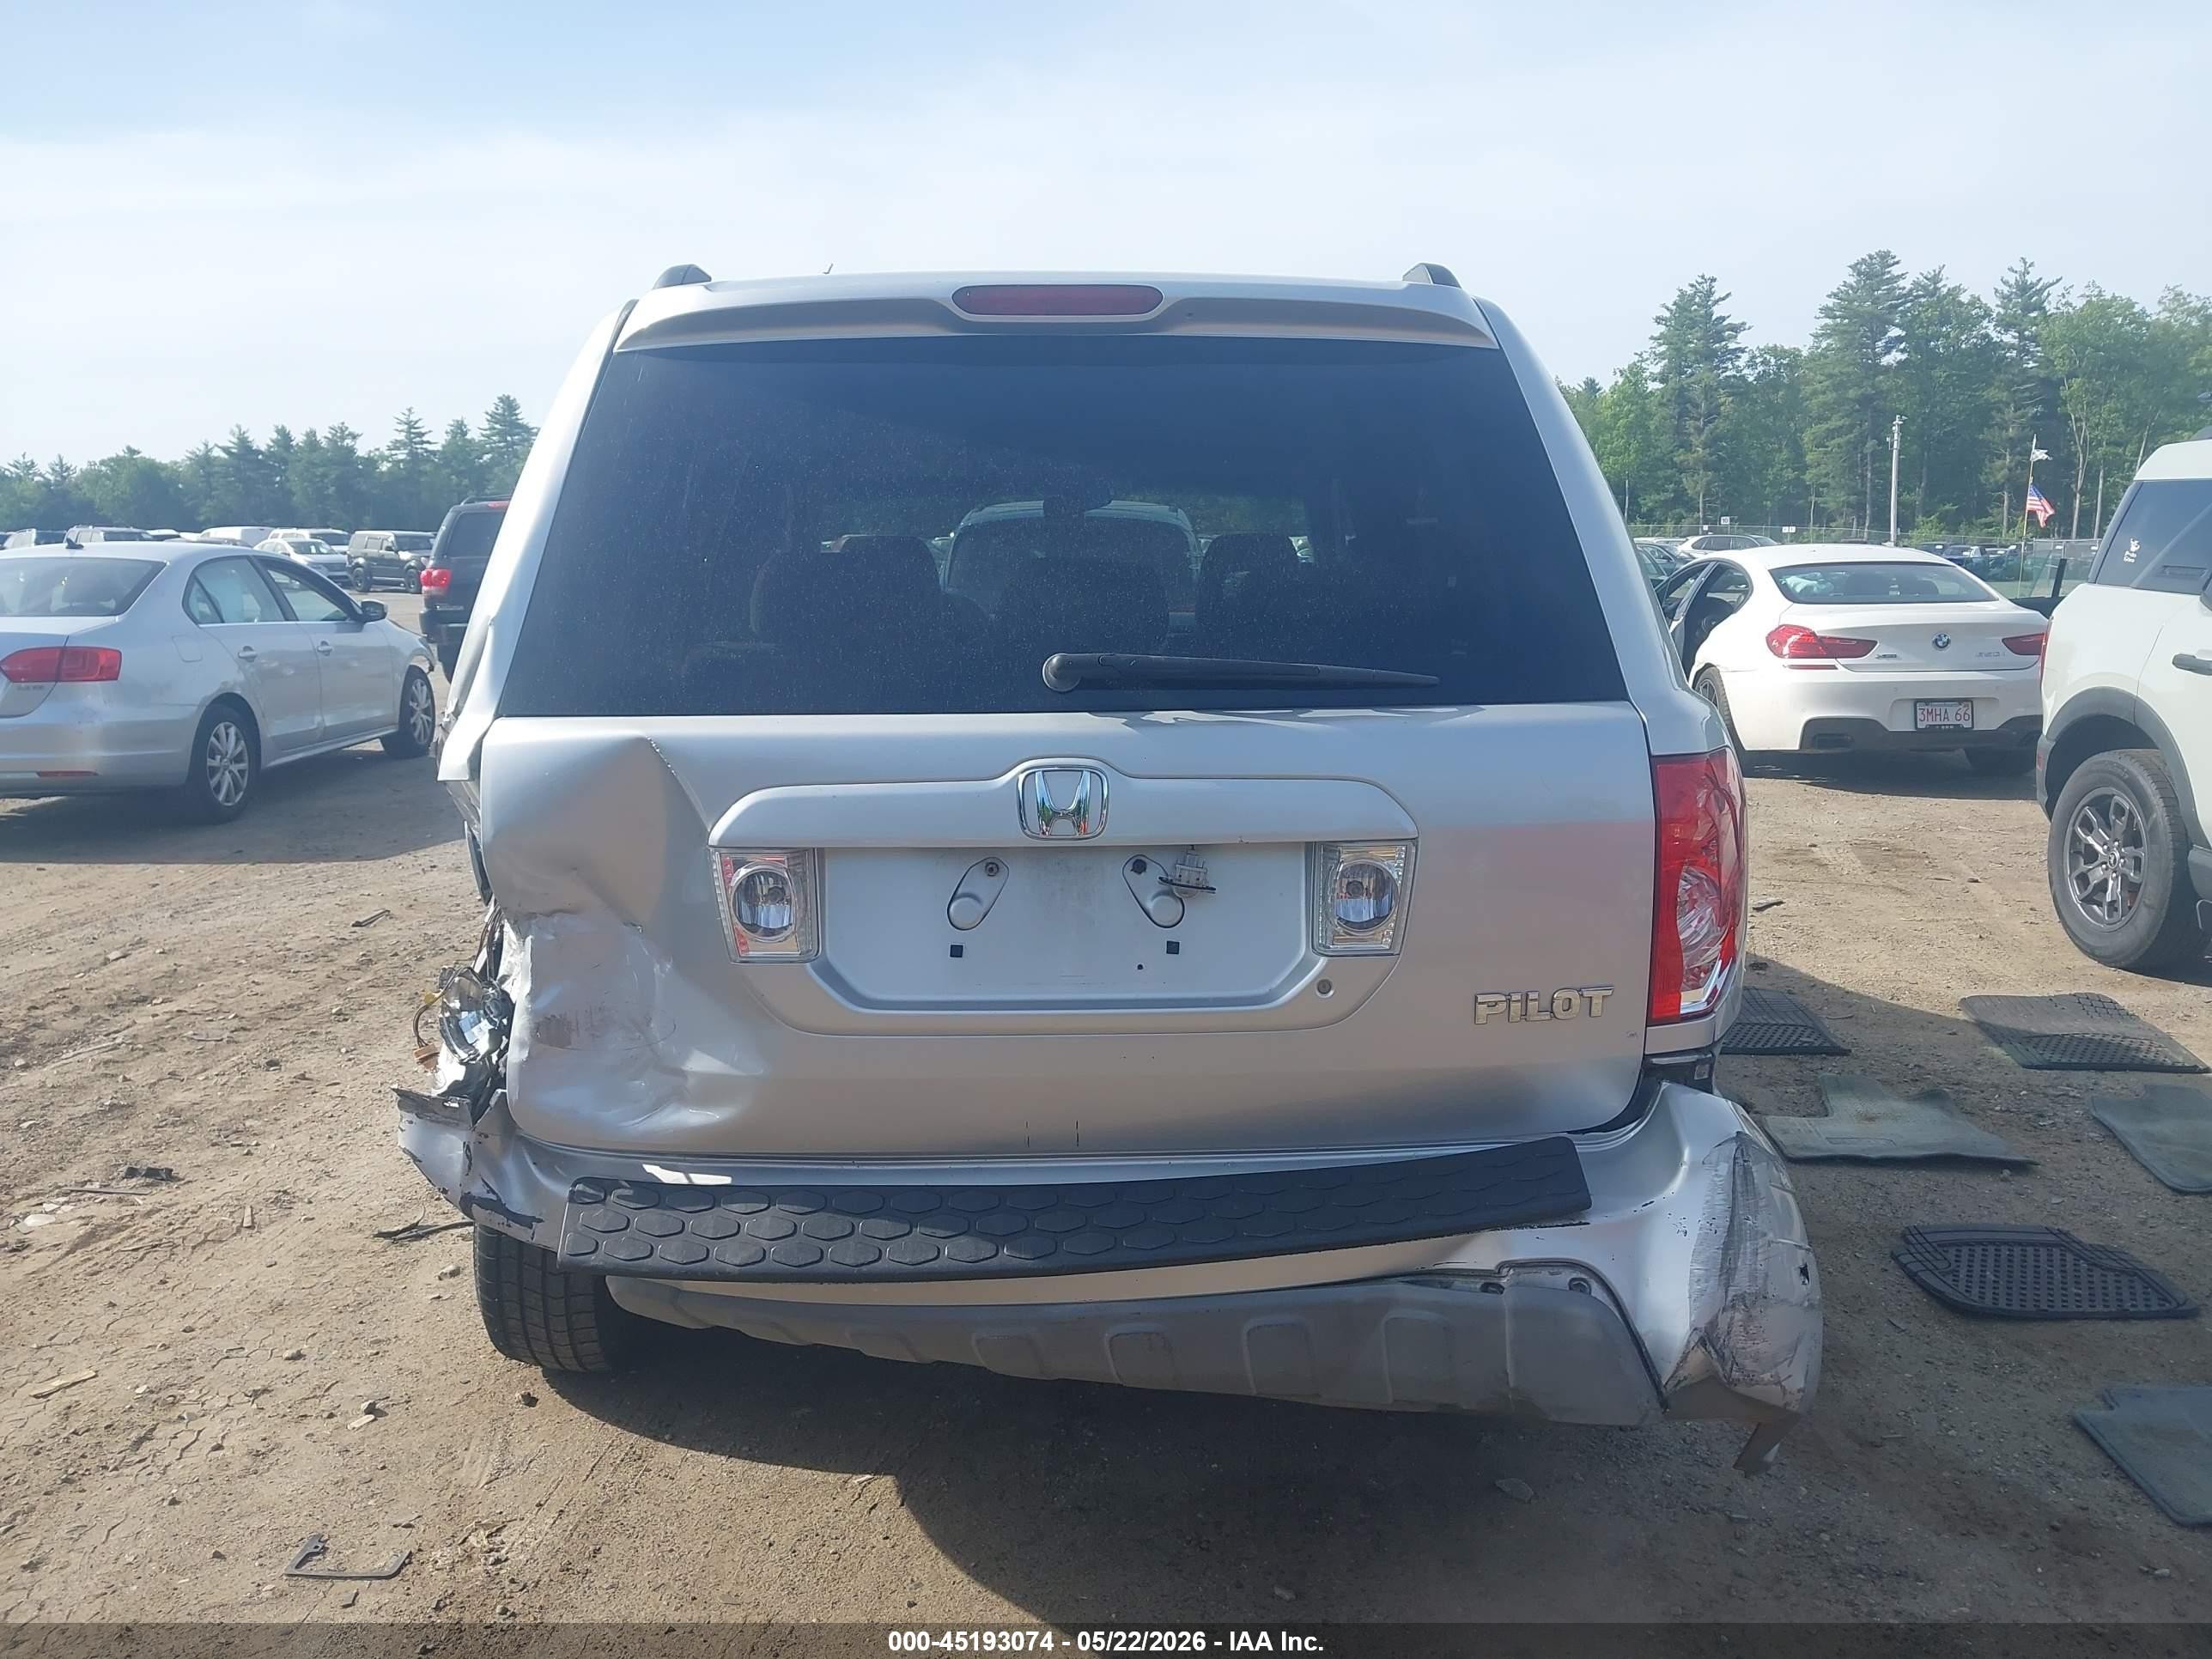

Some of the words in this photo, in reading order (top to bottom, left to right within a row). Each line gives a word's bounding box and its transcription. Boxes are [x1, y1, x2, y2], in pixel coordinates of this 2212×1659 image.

[1918, 708, 1949, 722] 3MHA
[1954, 708, 1970, 722] 66
[1474, 986, 1614, 1024] PILOT
